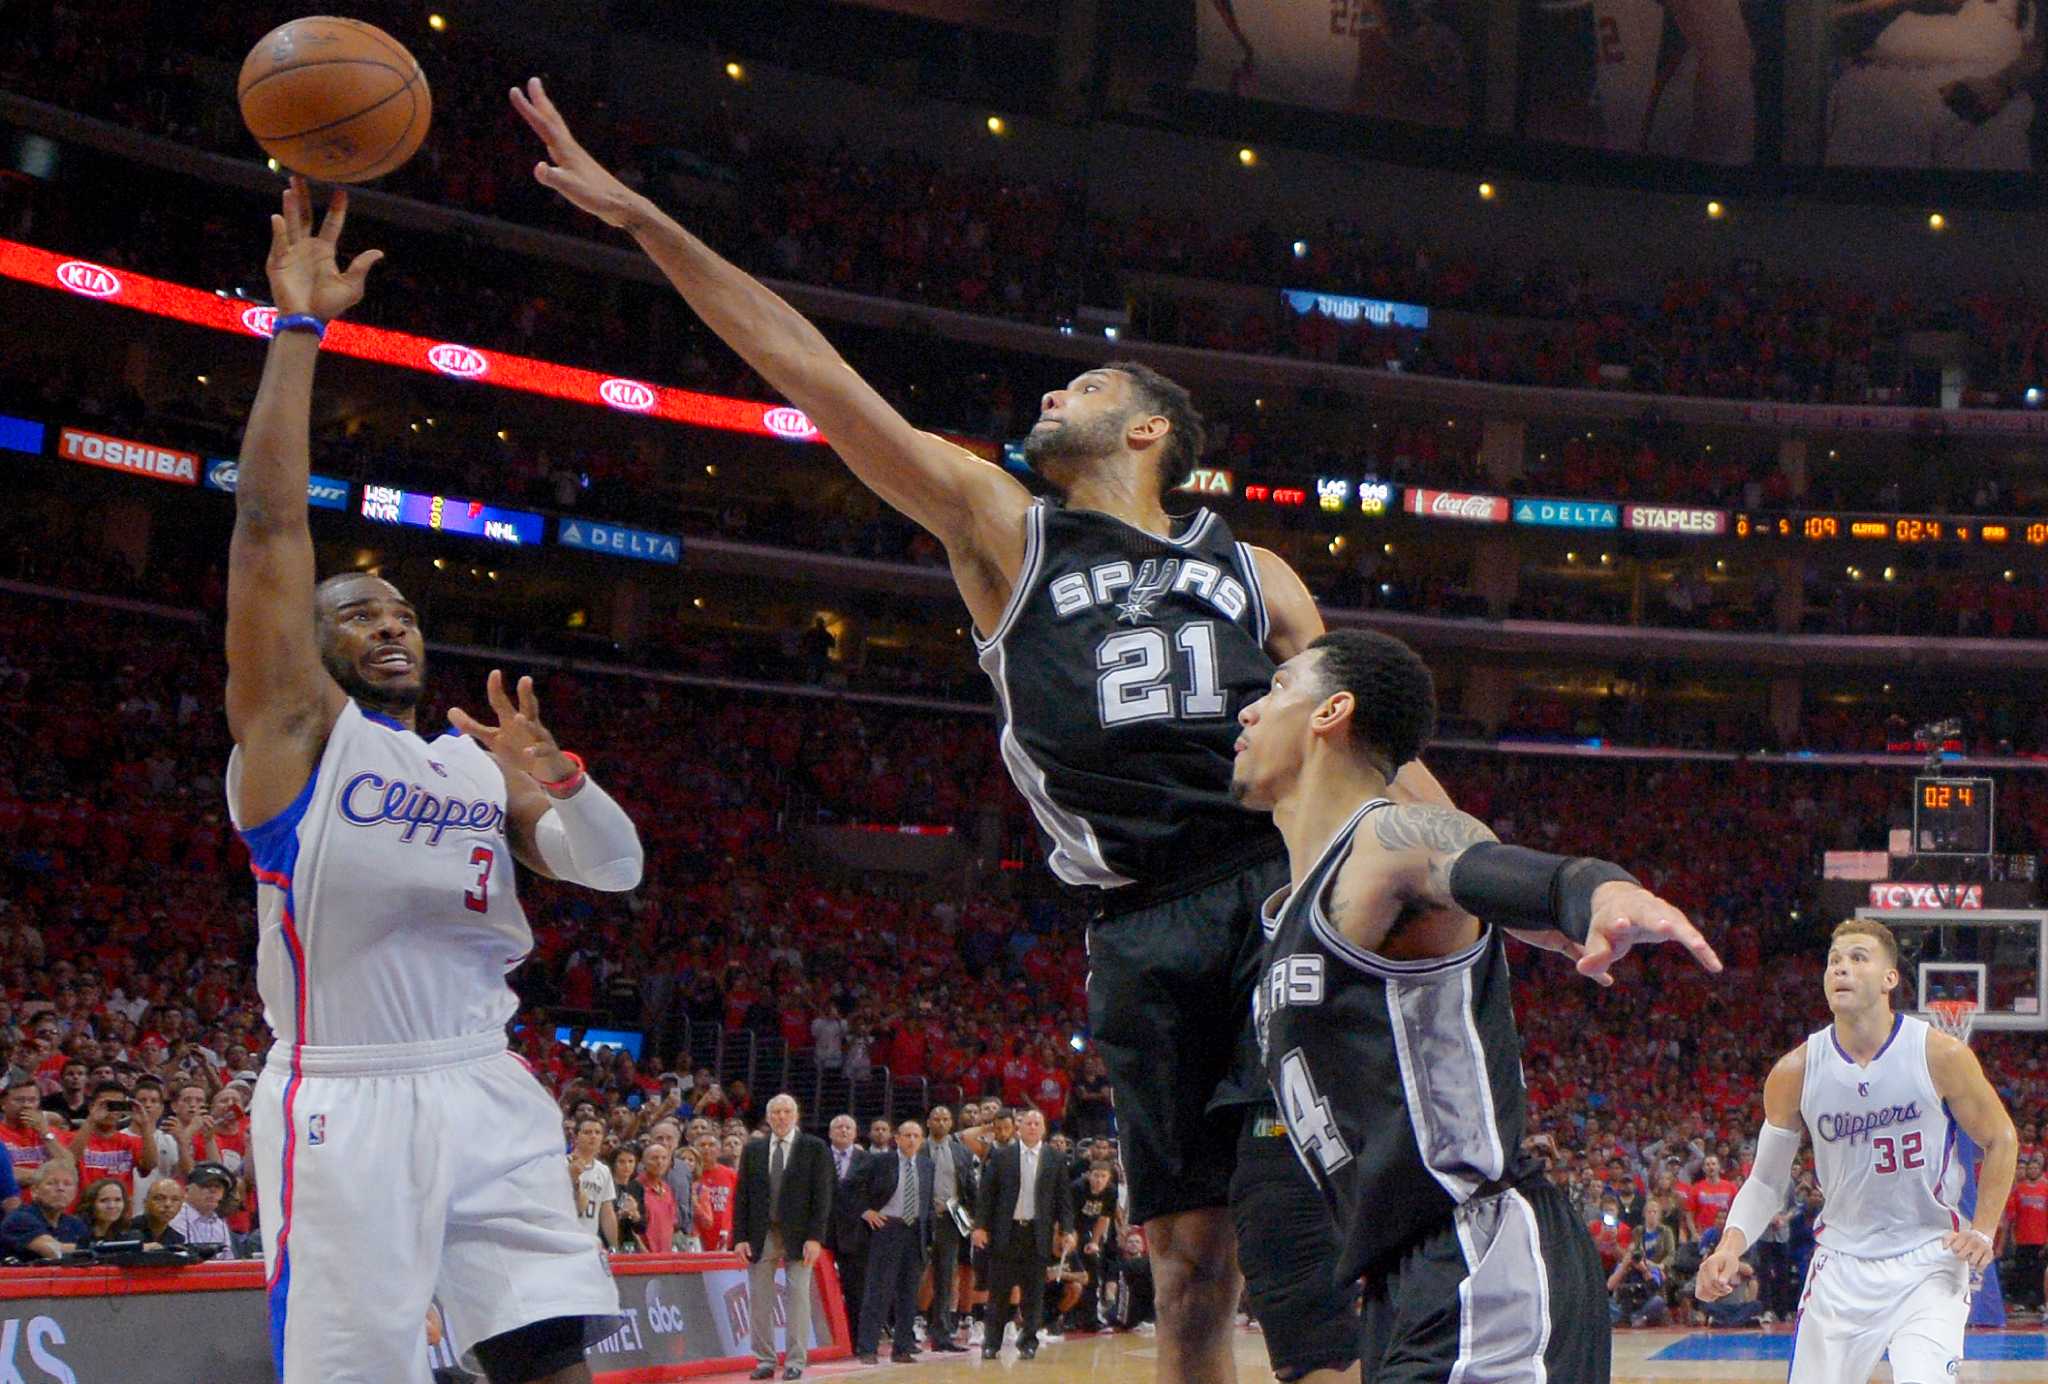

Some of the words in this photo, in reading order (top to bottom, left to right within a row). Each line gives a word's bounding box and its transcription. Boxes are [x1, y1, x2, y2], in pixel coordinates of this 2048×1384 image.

[67, 264, 109, 293] KIA
[438, 348, 476, 371] KIA
[609, 382, 644, 407] KIA
[773, 413, 810, 433] KIA
[64, 432, 196, 481] TOSHIBA
[1317, 478, 1347, 496] LAC
[361, 501, 400, 523] NYR
[1541, 505, 1614, 523] DELTA
[1631, 507, 1717, 532] STAPLES
[484, 520, 520, 543] NHL
[590, 527, 679, 559] DELTA
[1804, 518, 1836, 538] 109
[1050, 559, 1247, 624] SPURS
[1096, 621, 1228, 728] 21
[337, 770, 505, 846] Clipper
[464, 846, 494, 914] 3
[1281, 1047, 1353, 1175] 4
[1817, 1101, 1922, 1145] Clippers
[1872, 1130, 1925, 1175] 32
[648, 1296, 684, 1333] abc
